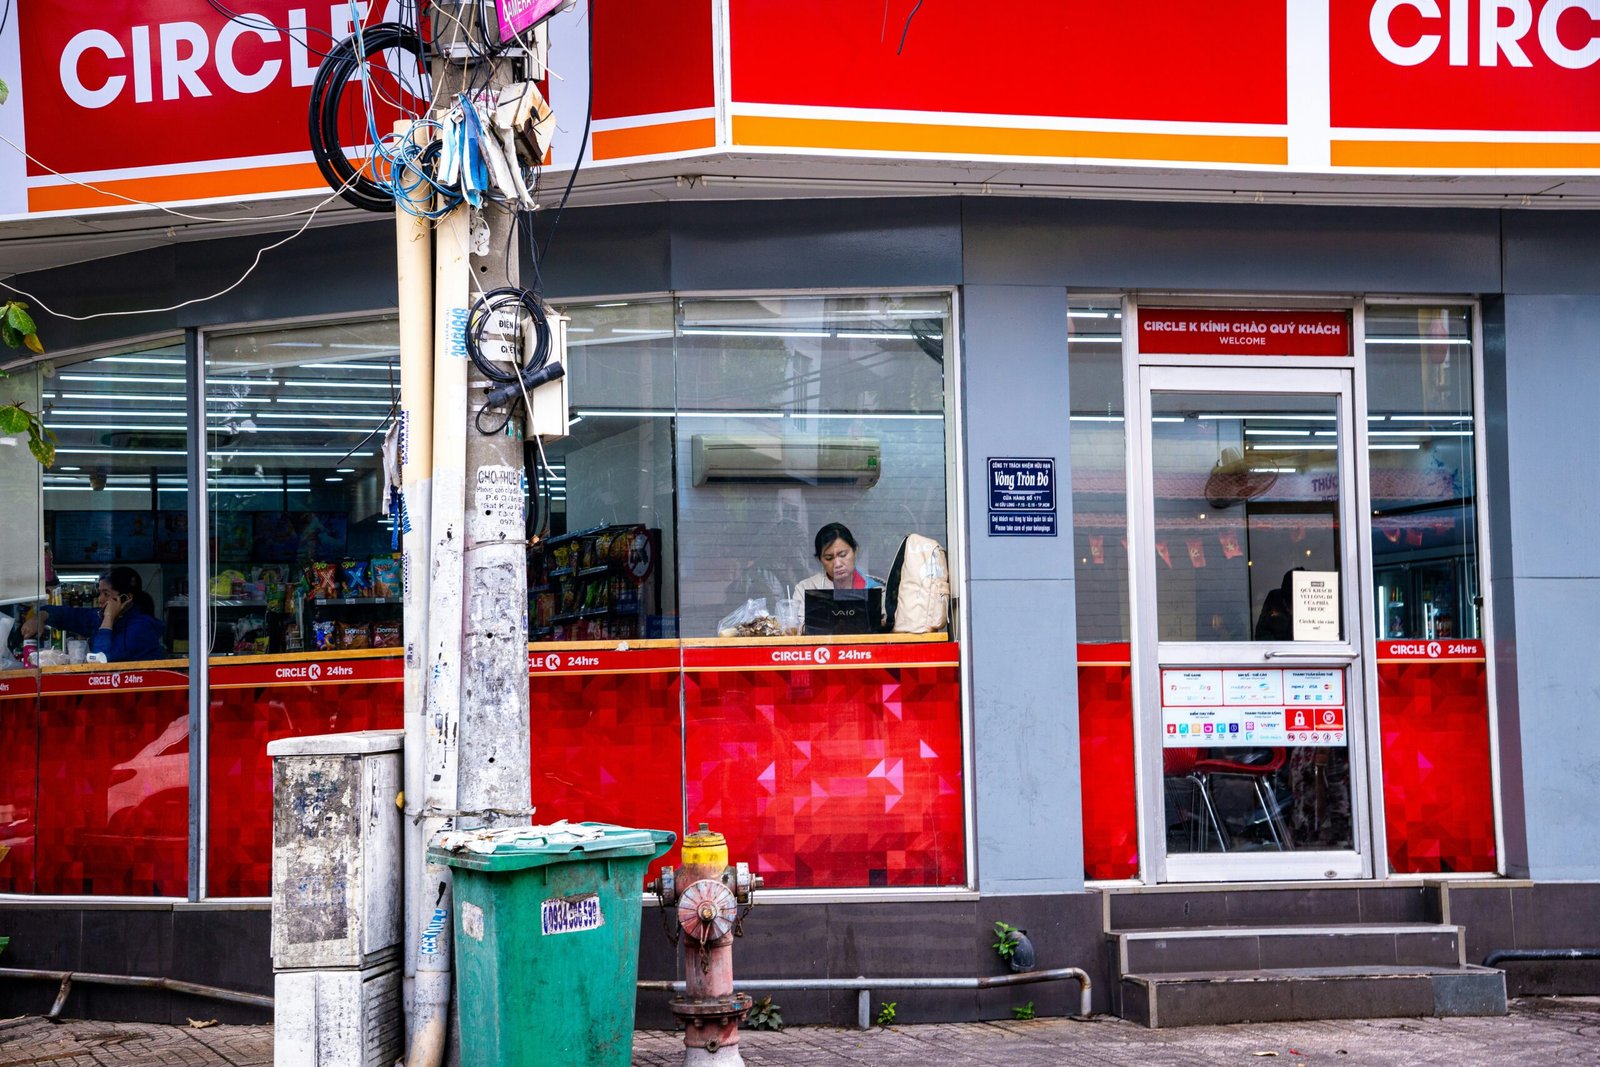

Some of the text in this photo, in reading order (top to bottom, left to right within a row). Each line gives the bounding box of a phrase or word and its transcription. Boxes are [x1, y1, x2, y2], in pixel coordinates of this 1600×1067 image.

[1369, 0, 1600, 69] CIRC
[59, 1, 370, 109] CIRCLE
[1144, 320, 1341, 335] CIRCLE K KÍNH CHÀO QUÝ KHÁCH
[1219, 337, 1266, 345] WELCOME
[994, 470, 1049, 490] Vòng Tròn Đỏ
[832, 609, 855, 617] VAIO
[771, 647, 872, 664] CIRCLE K 24hrs
[1390, 642, 1477, 658] CIRCLE K 24hrs
[545, 653, 561, 670] K
[567, 655, 599, 667] 24hrs
[275, 663, 353, 679] CIRCLE K 24hrs
[88, 673, 143, 688] CIRCLE K 24hrs
